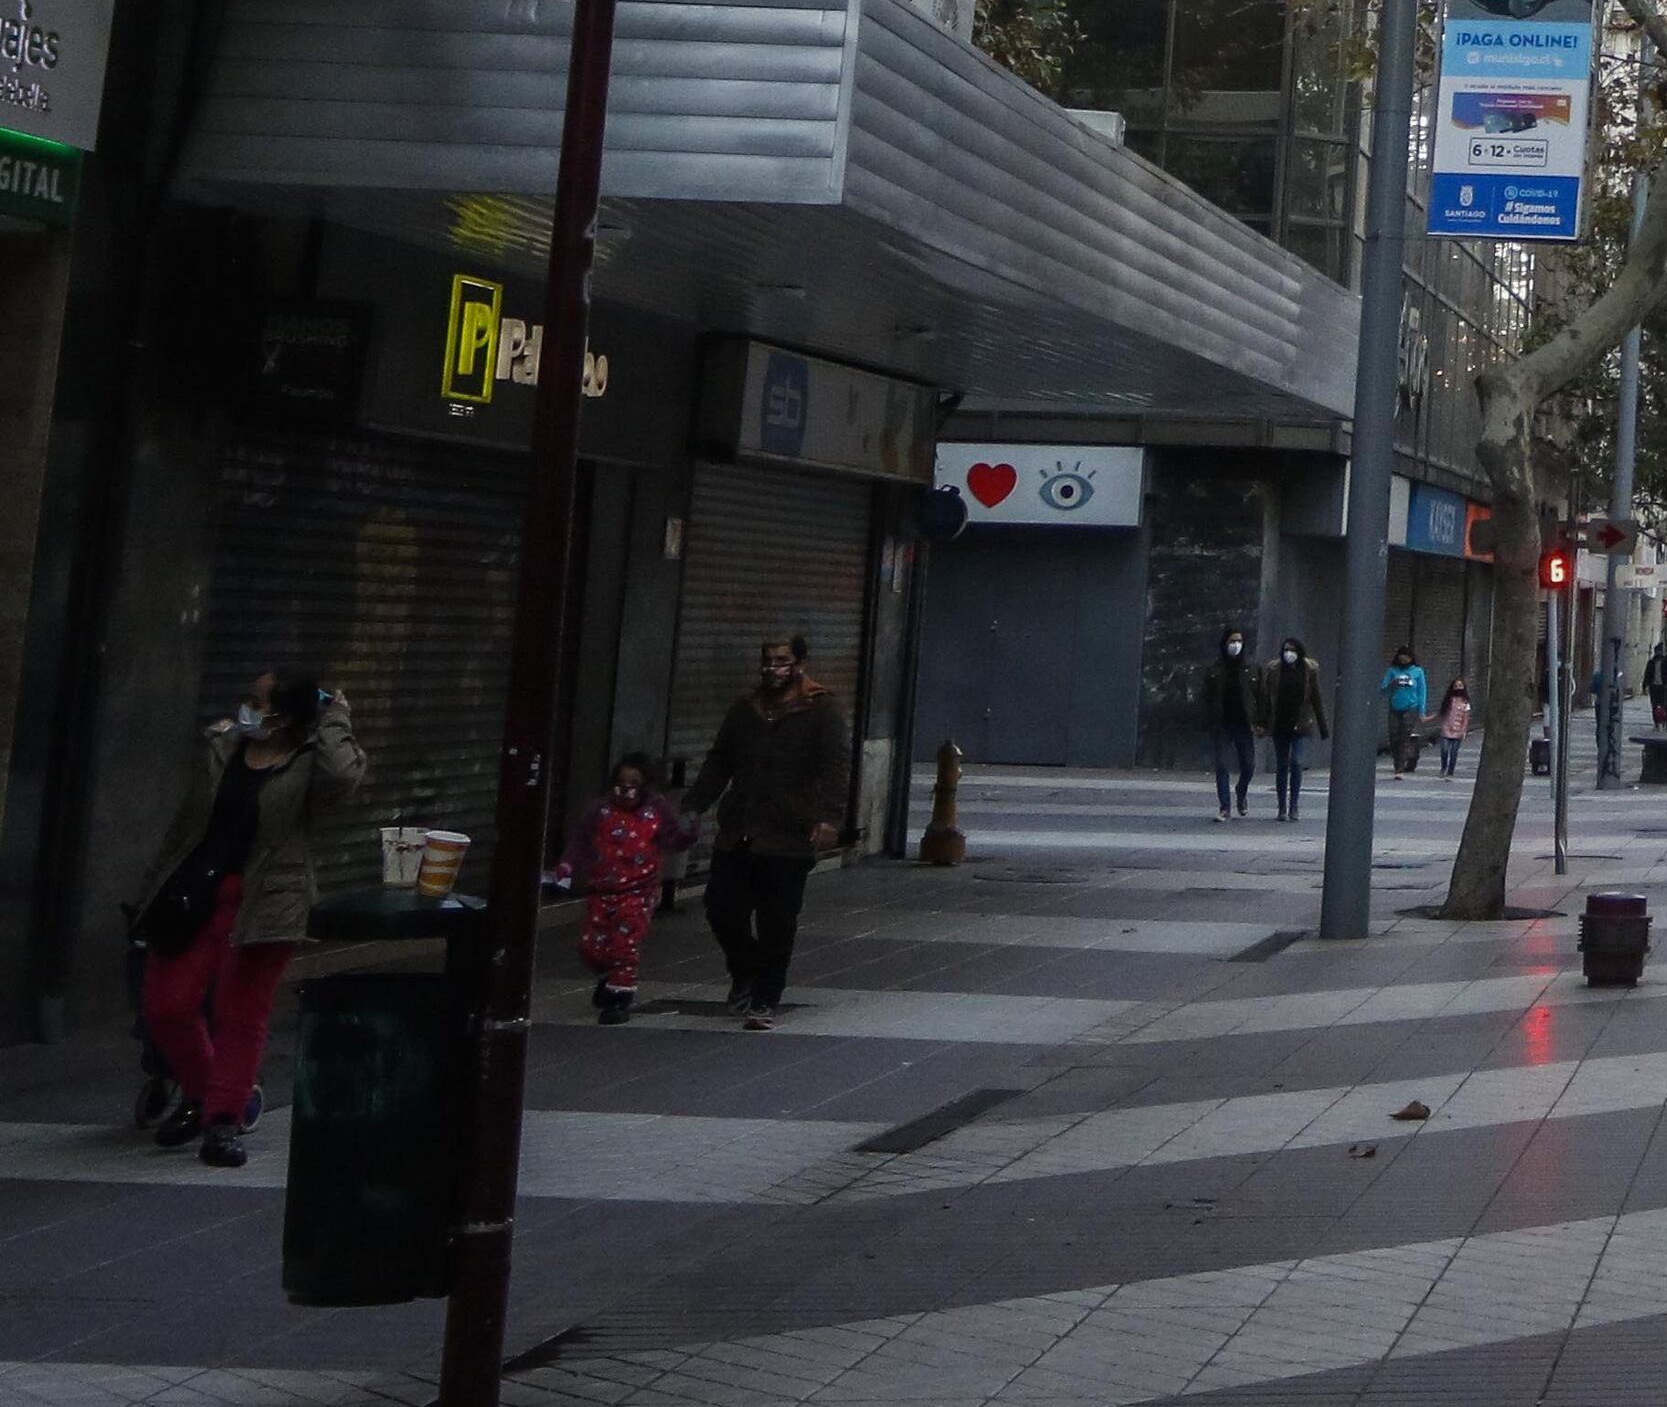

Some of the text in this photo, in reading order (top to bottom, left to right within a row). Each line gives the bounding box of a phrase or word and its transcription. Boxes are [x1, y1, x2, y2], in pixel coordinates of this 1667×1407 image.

[0, 18, 60, 72] ajes
[1456, 33, 1578, 49] ¡PAGA ONLINE!
[1472, 144, 1482, 157] 6
[1491, 145, 1505, 158] 12
[1505, 201, 1556, 214] #Sigamos
[496, 317, 609, 398] Palbo
[1550, 558, 1565, 583] 6
